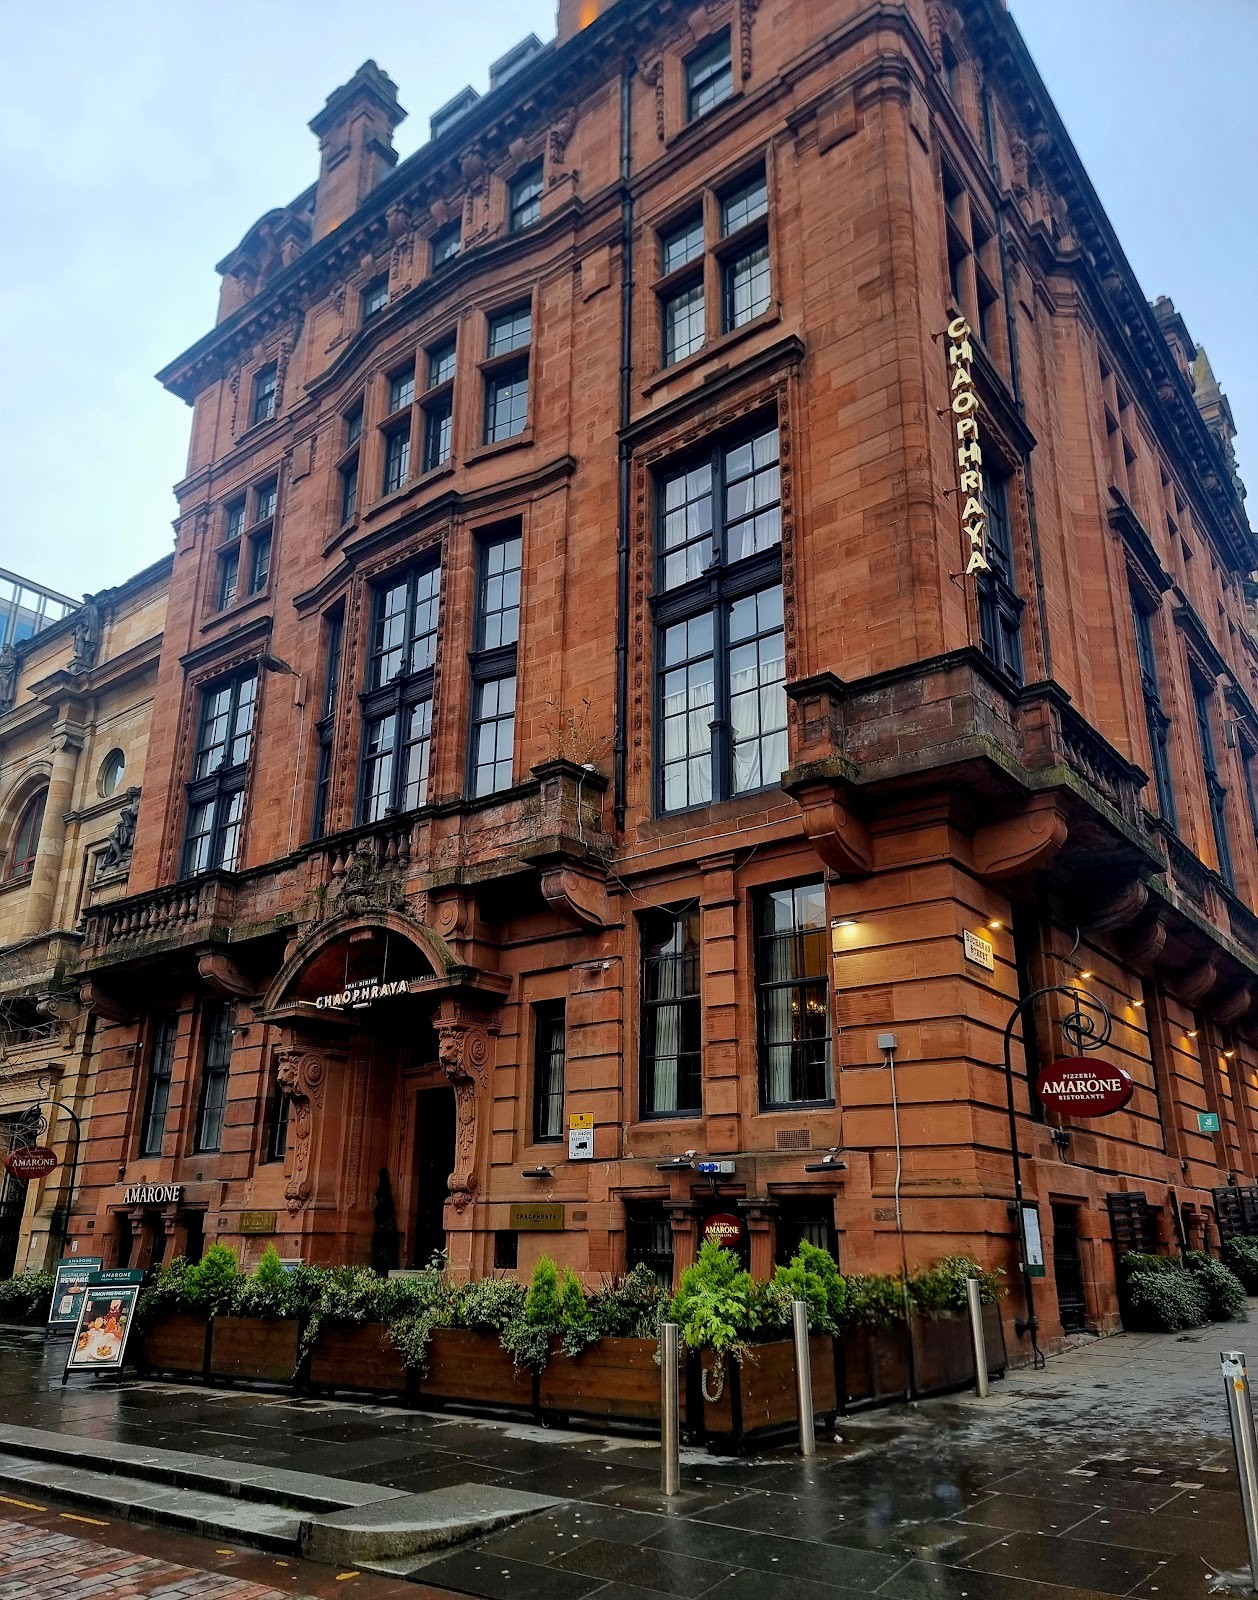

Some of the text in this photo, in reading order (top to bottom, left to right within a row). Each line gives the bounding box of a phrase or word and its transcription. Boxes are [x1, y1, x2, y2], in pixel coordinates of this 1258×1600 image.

[947, 316, 991, 575] CHAOPHRAYA
[315, 980, 409, 1009] CHAOPHRAYA
[1062, 1072, 1097, 1080] PIZZERIA
[1041, 1078, 1122, 1094] AMARONE
[1058, 1093, 1105, 1101] RISTORANTE
[11, 1158, 55, 1167] AMARONE
[122, 1185, 180, 1203] AMARONE
[705, 1225, 740, 1234] AMARONE
